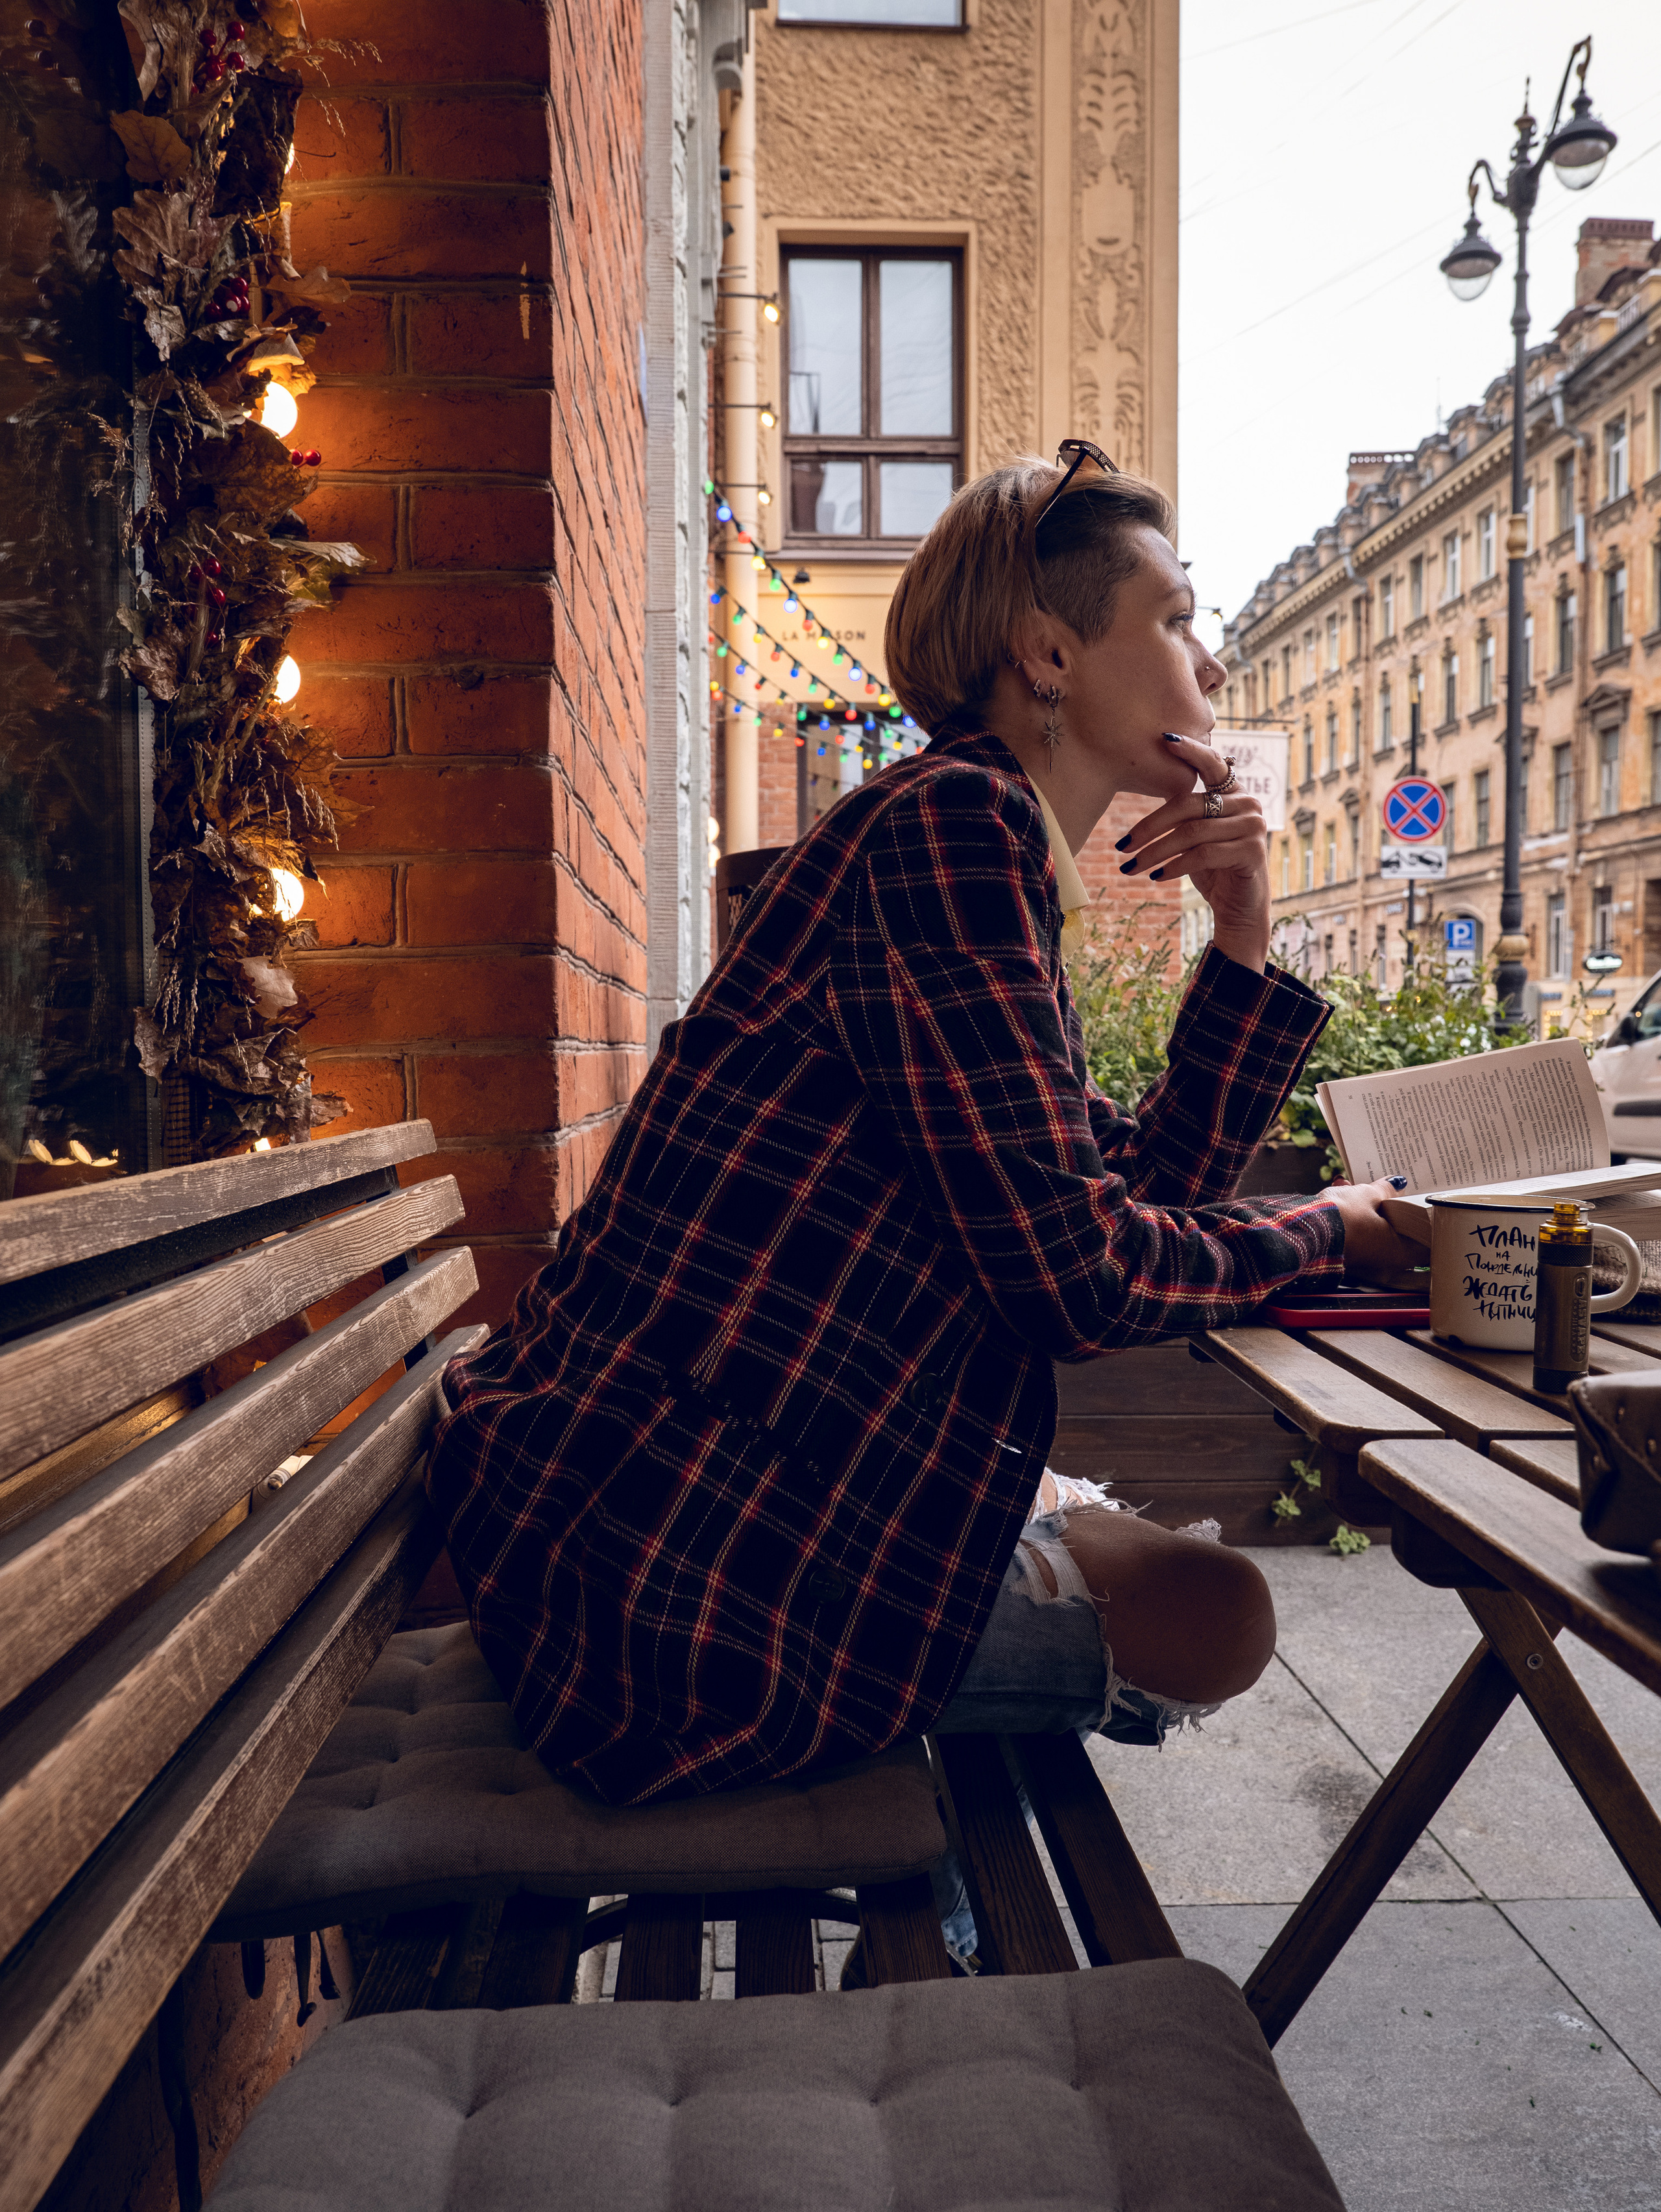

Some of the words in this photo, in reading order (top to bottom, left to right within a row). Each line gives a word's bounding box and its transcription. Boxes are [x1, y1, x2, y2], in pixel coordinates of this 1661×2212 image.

[806, 631, 866, 640] MSON
[1469, 1224, 1535, 1252] ПЛАН
[1577, 1299, 1587, 1354] ASVAPE
